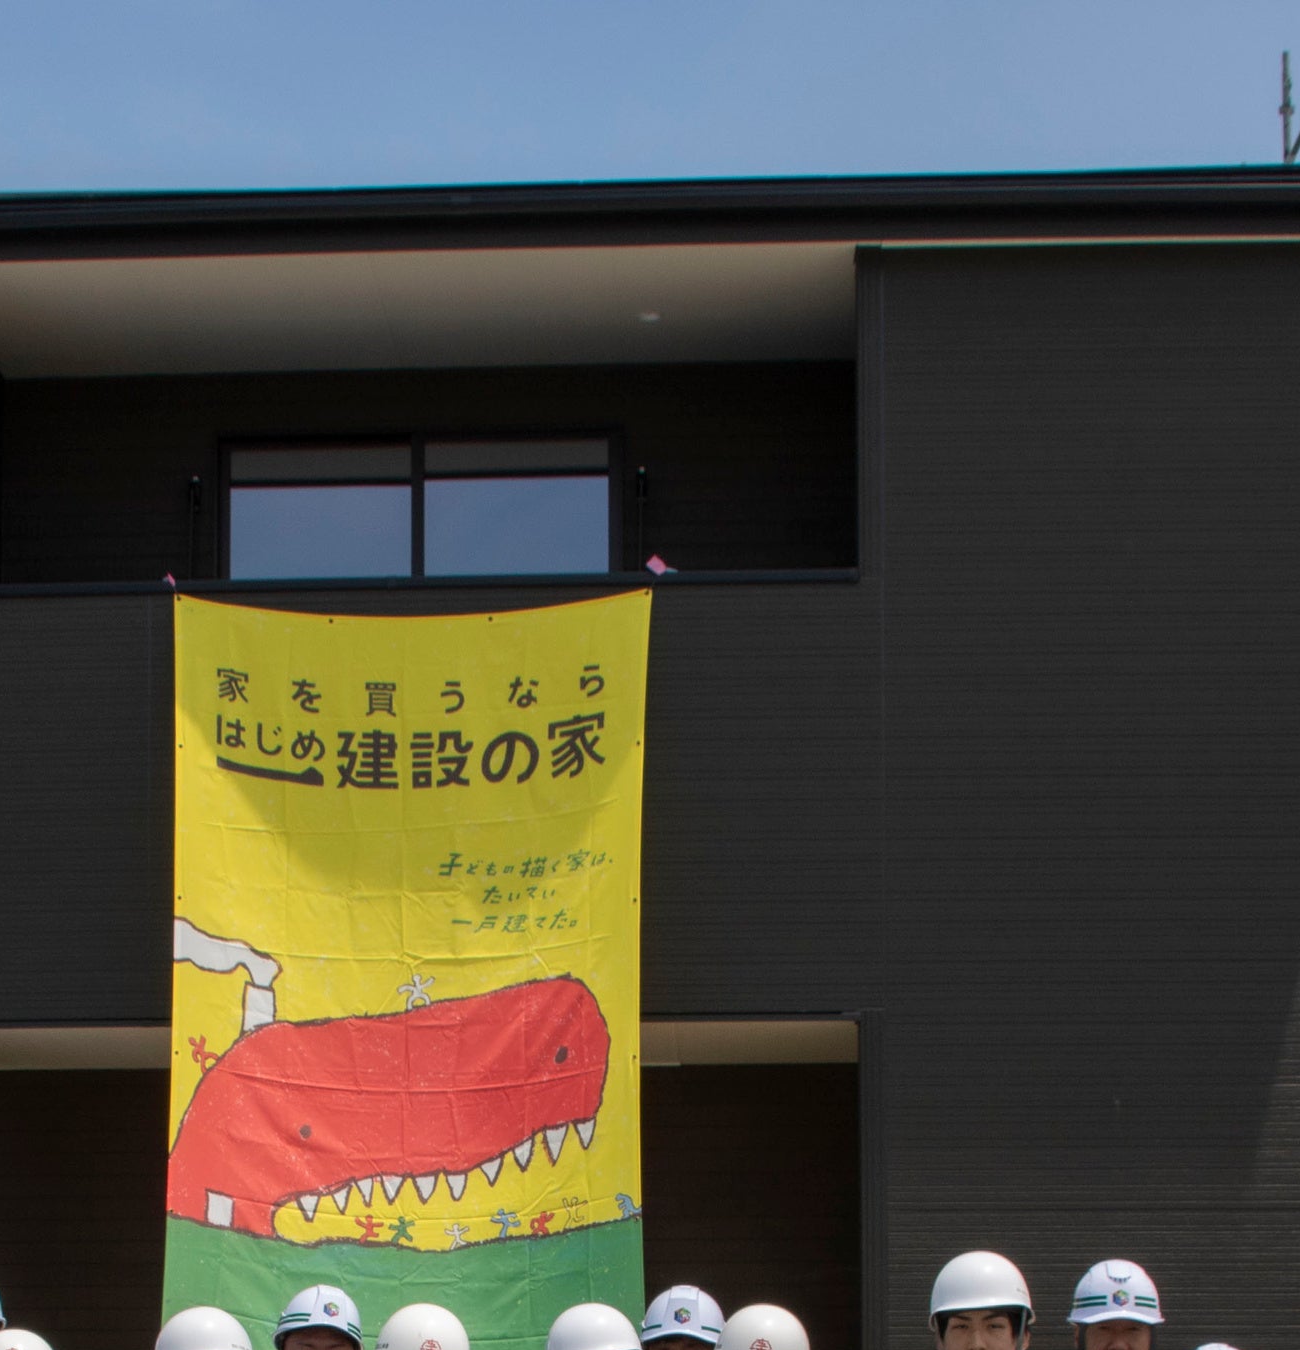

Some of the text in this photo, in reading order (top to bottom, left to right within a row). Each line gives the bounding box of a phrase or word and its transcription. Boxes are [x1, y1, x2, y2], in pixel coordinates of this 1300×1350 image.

[216, 664, 605, 717] 家を買うなら
[216, 714, 326, 762] はじめ
